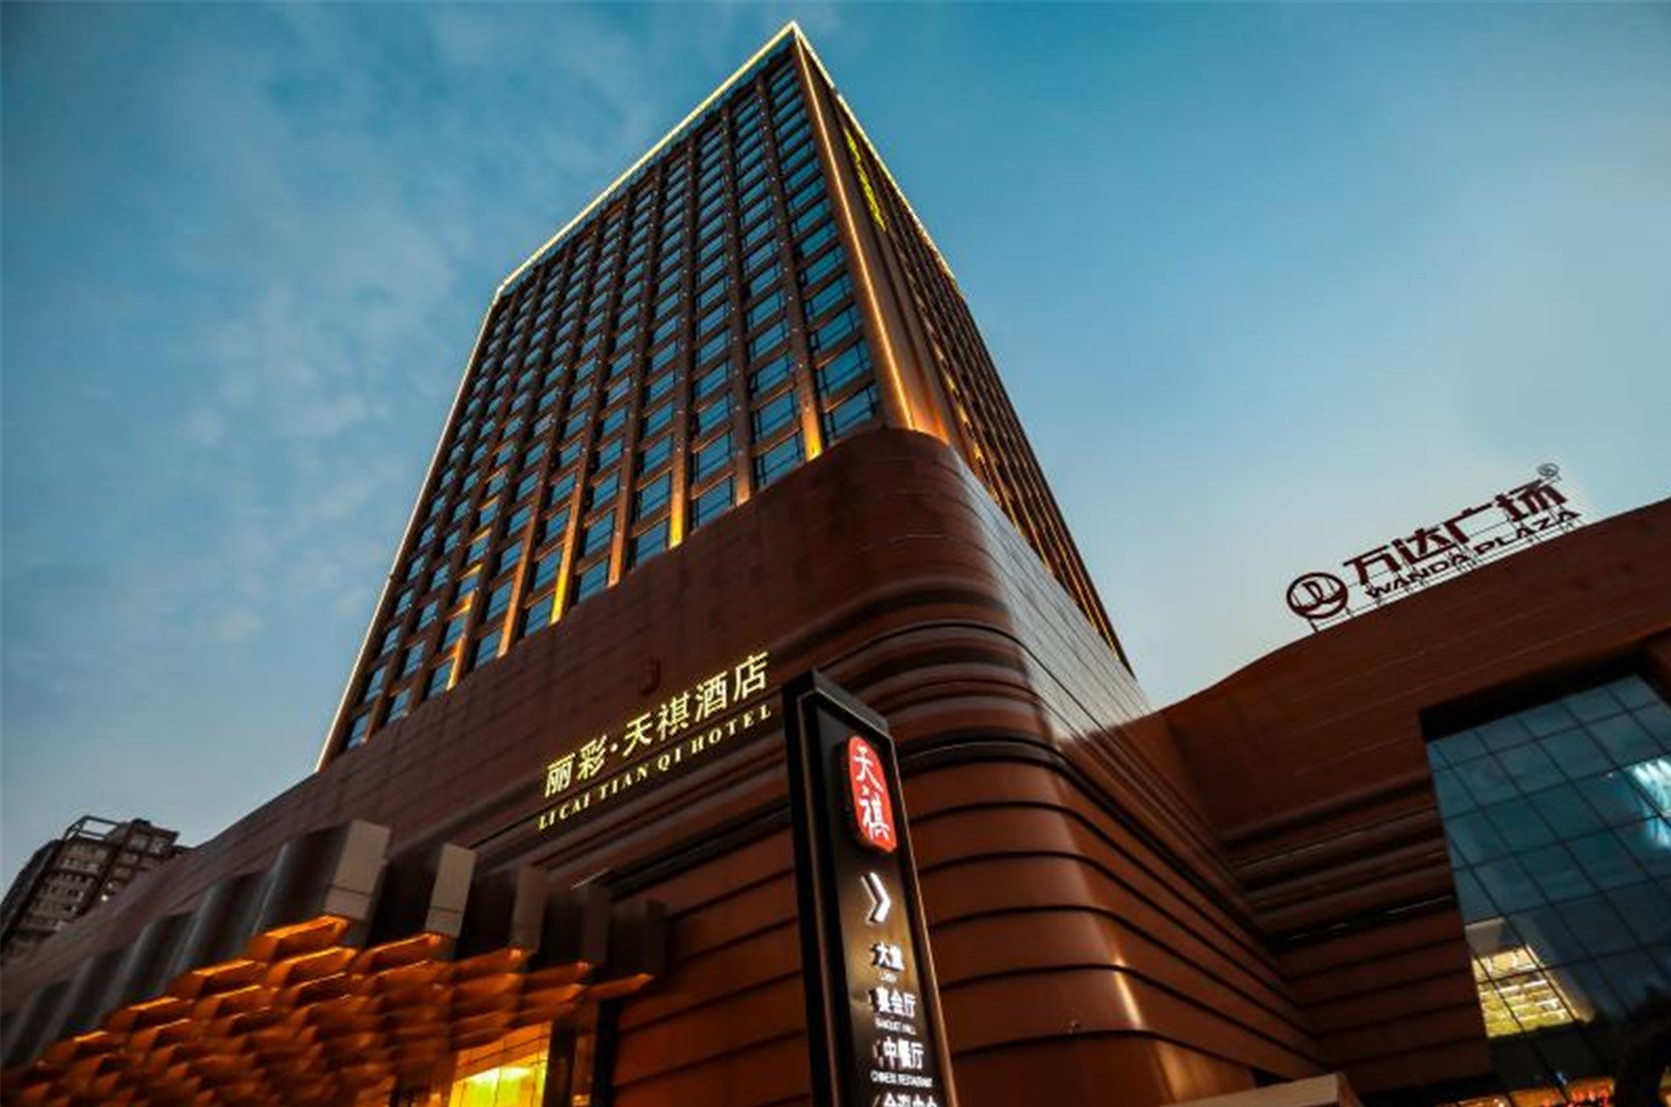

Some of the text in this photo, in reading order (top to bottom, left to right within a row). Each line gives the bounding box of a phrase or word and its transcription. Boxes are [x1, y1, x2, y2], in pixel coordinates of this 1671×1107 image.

[1343, 479, 1568, 586] 万达广场
[1365, 510, 1581, 599] WANDA PLAZA
[537, 703, 772, 831] LICAI TIAN QI HOTEL
